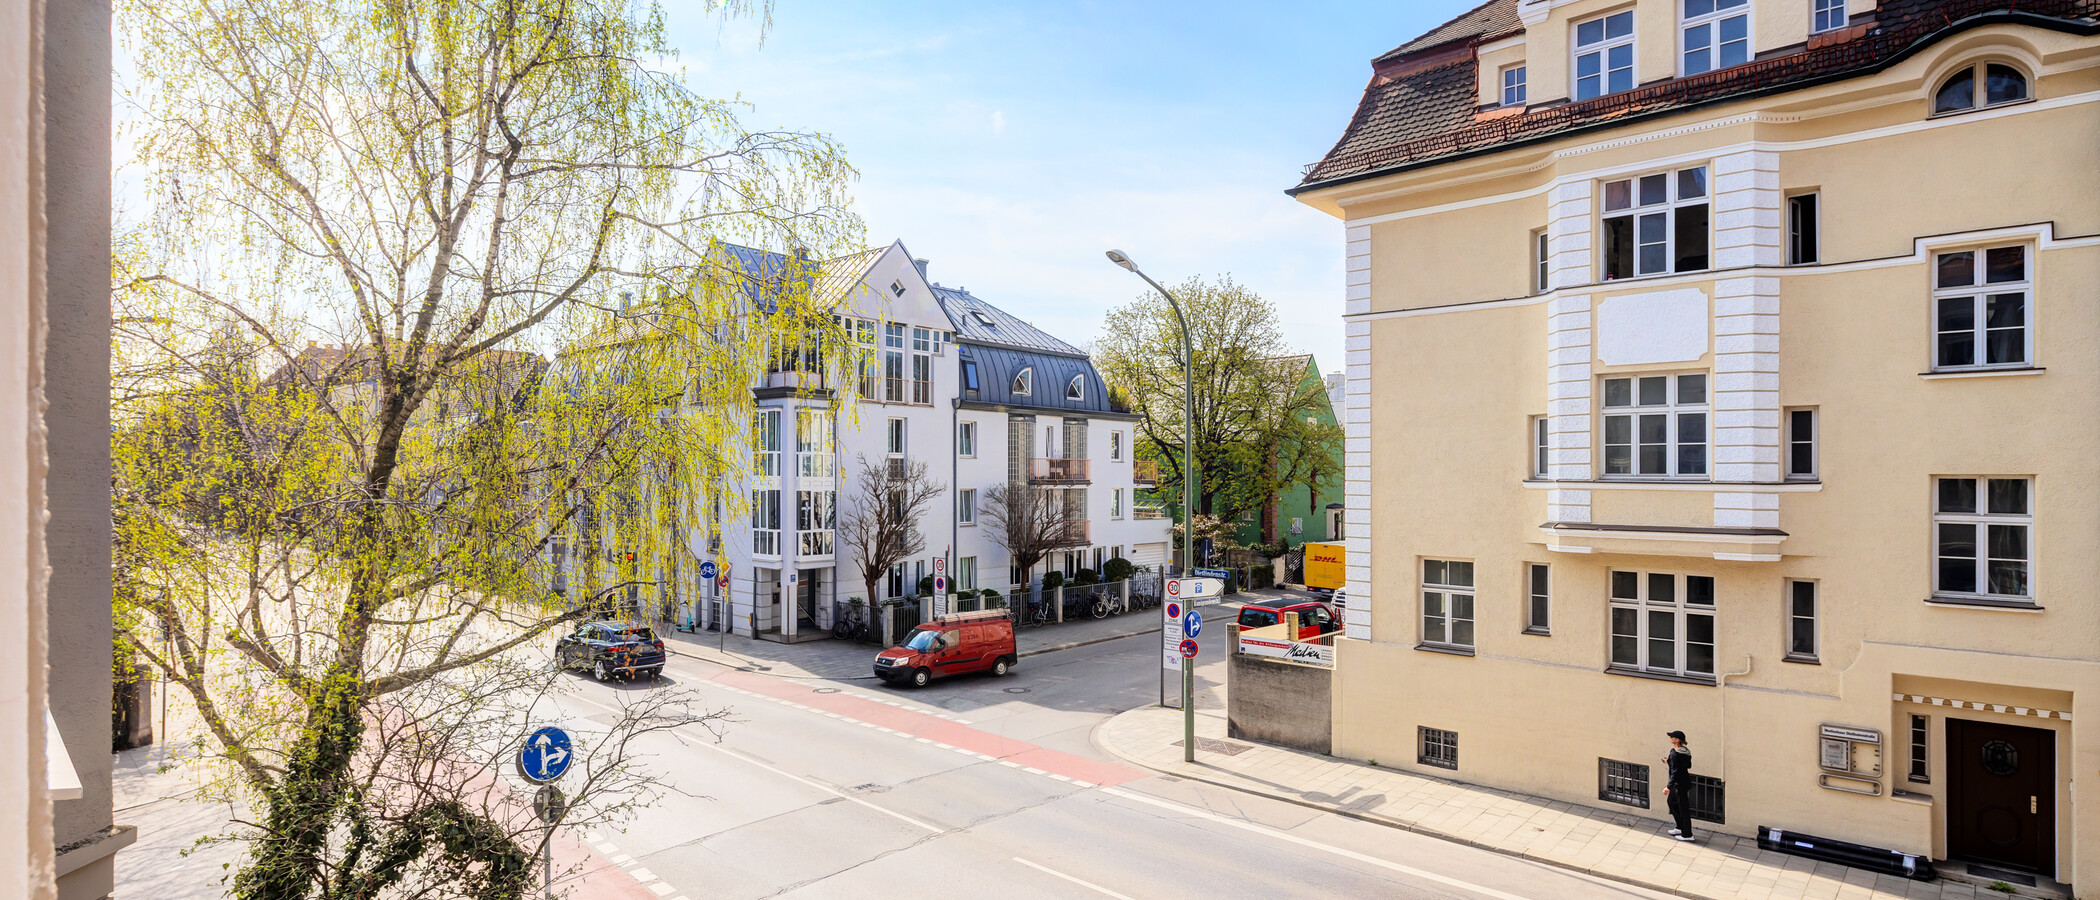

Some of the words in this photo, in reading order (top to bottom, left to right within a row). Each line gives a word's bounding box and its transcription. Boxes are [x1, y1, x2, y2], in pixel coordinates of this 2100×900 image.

[1313, 555, 1337, 563] DHL
[1170, 584, 1178, 592] 30
[1285, 644, 1320, 659] Medien
